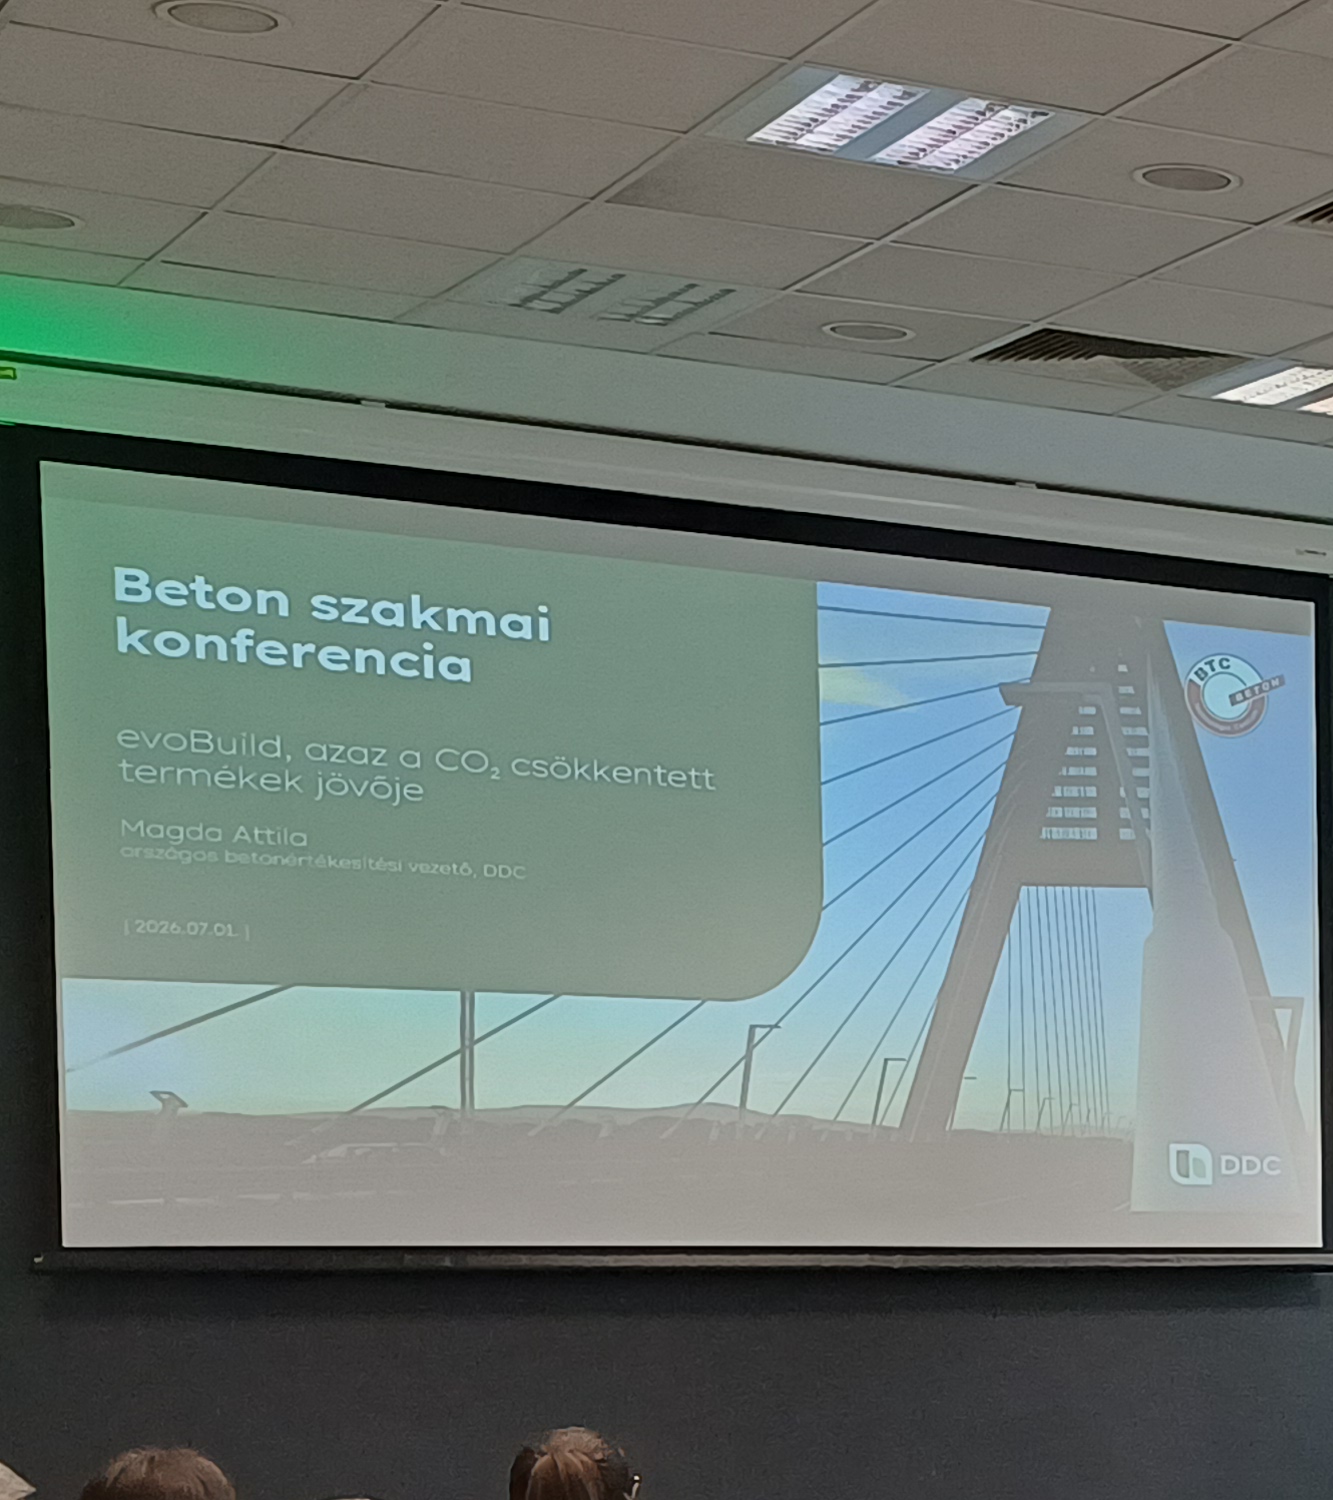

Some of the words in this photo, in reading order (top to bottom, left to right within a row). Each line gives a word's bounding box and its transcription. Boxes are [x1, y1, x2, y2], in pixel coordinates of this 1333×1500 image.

[114, 566, 289, 617] Beton
[310, 593, 549, 641] szakmai
[116, 616, 471, 682] konferencia
[1193, 657, 1231, 682] BTC
[1234, 676, 1281, 702] BETON
[116, 729, 292, 763] evoBuild,
[305, 742, 388, 767] azaz
[399, 750, 421, 768] a
[511, 756, 716, 790] csökkentett
[118, 759, 304, 793] termékek
[314, 772, 424, 806] jövője
[121, 819, 222, 845] Magda
[232, 825, 308, 847] Attila
[484, 864, 526, 879] DDC
[1220, 1154, 1281, 1175] DDC
